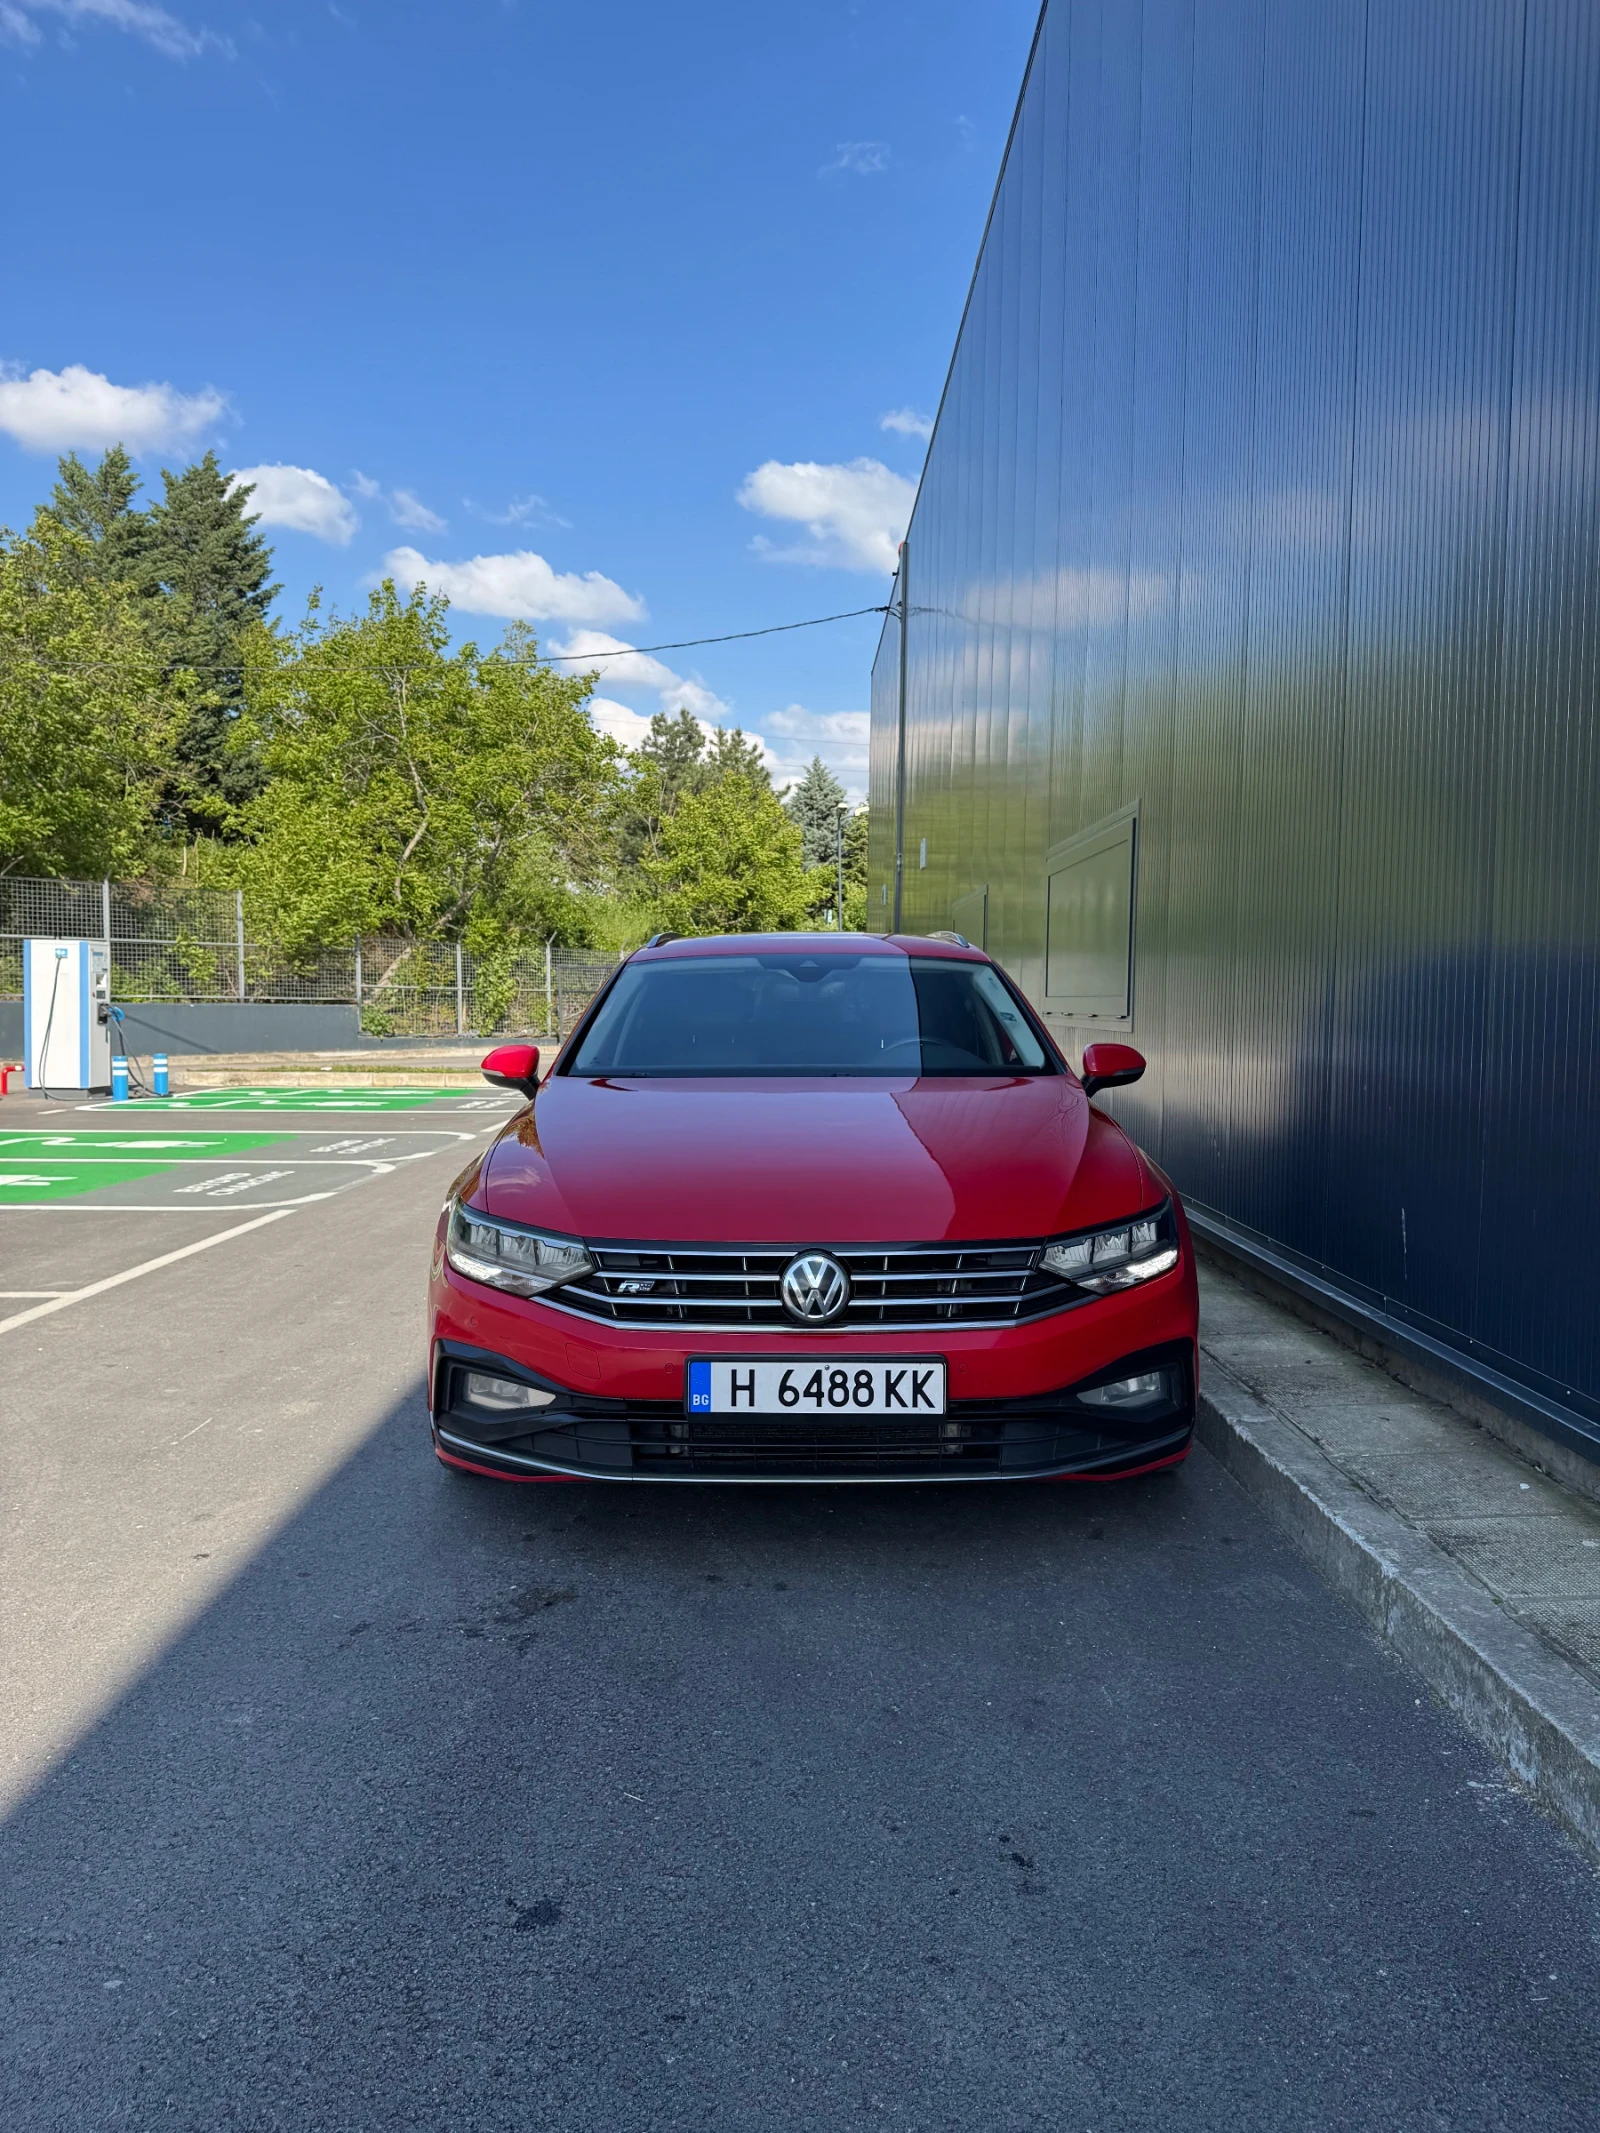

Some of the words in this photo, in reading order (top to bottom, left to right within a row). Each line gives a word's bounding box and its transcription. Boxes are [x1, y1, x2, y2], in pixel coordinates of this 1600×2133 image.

[692, 1394, 709, 1406] BG
[730, 1369, 755, 1407] H
[778, 1369, 874, 1408] 6488
[885, 1369, 935, 1408] KK
